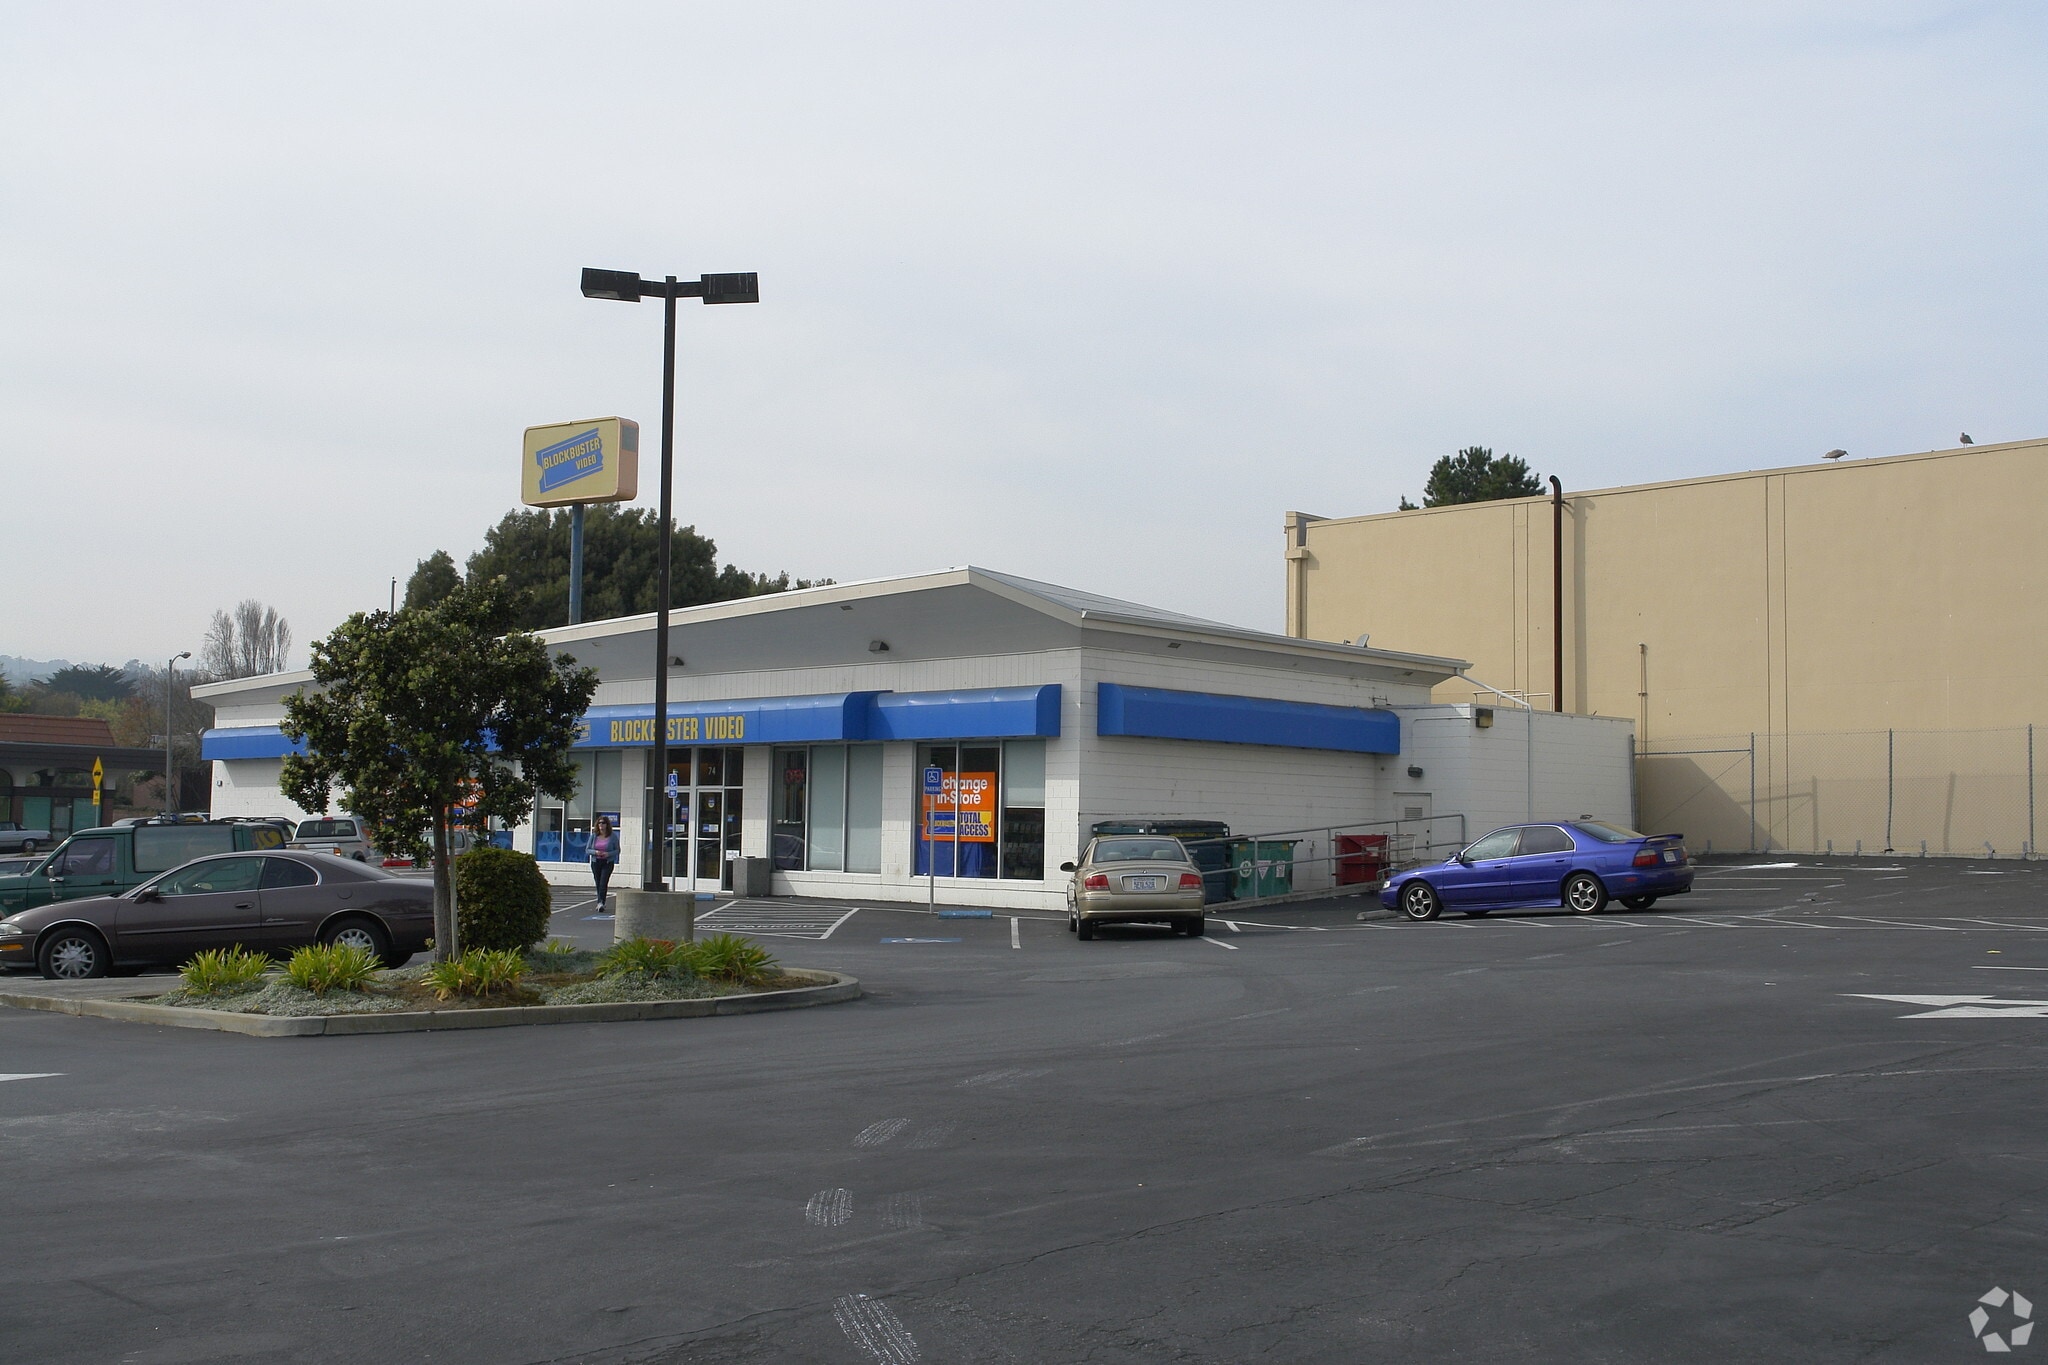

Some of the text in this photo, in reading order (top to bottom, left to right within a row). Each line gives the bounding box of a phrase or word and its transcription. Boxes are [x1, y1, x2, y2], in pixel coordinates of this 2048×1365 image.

[543, 437, 601, 470] BLOCKBUSTER
[575, 454, 597, 470] VIDEO
[705, 715, 744, 740] VIDEO
[708, 766, 716, 776] 74
[960, 812, 981, 824] TOTAL
[959, 824, 989, 836] ACCESS
